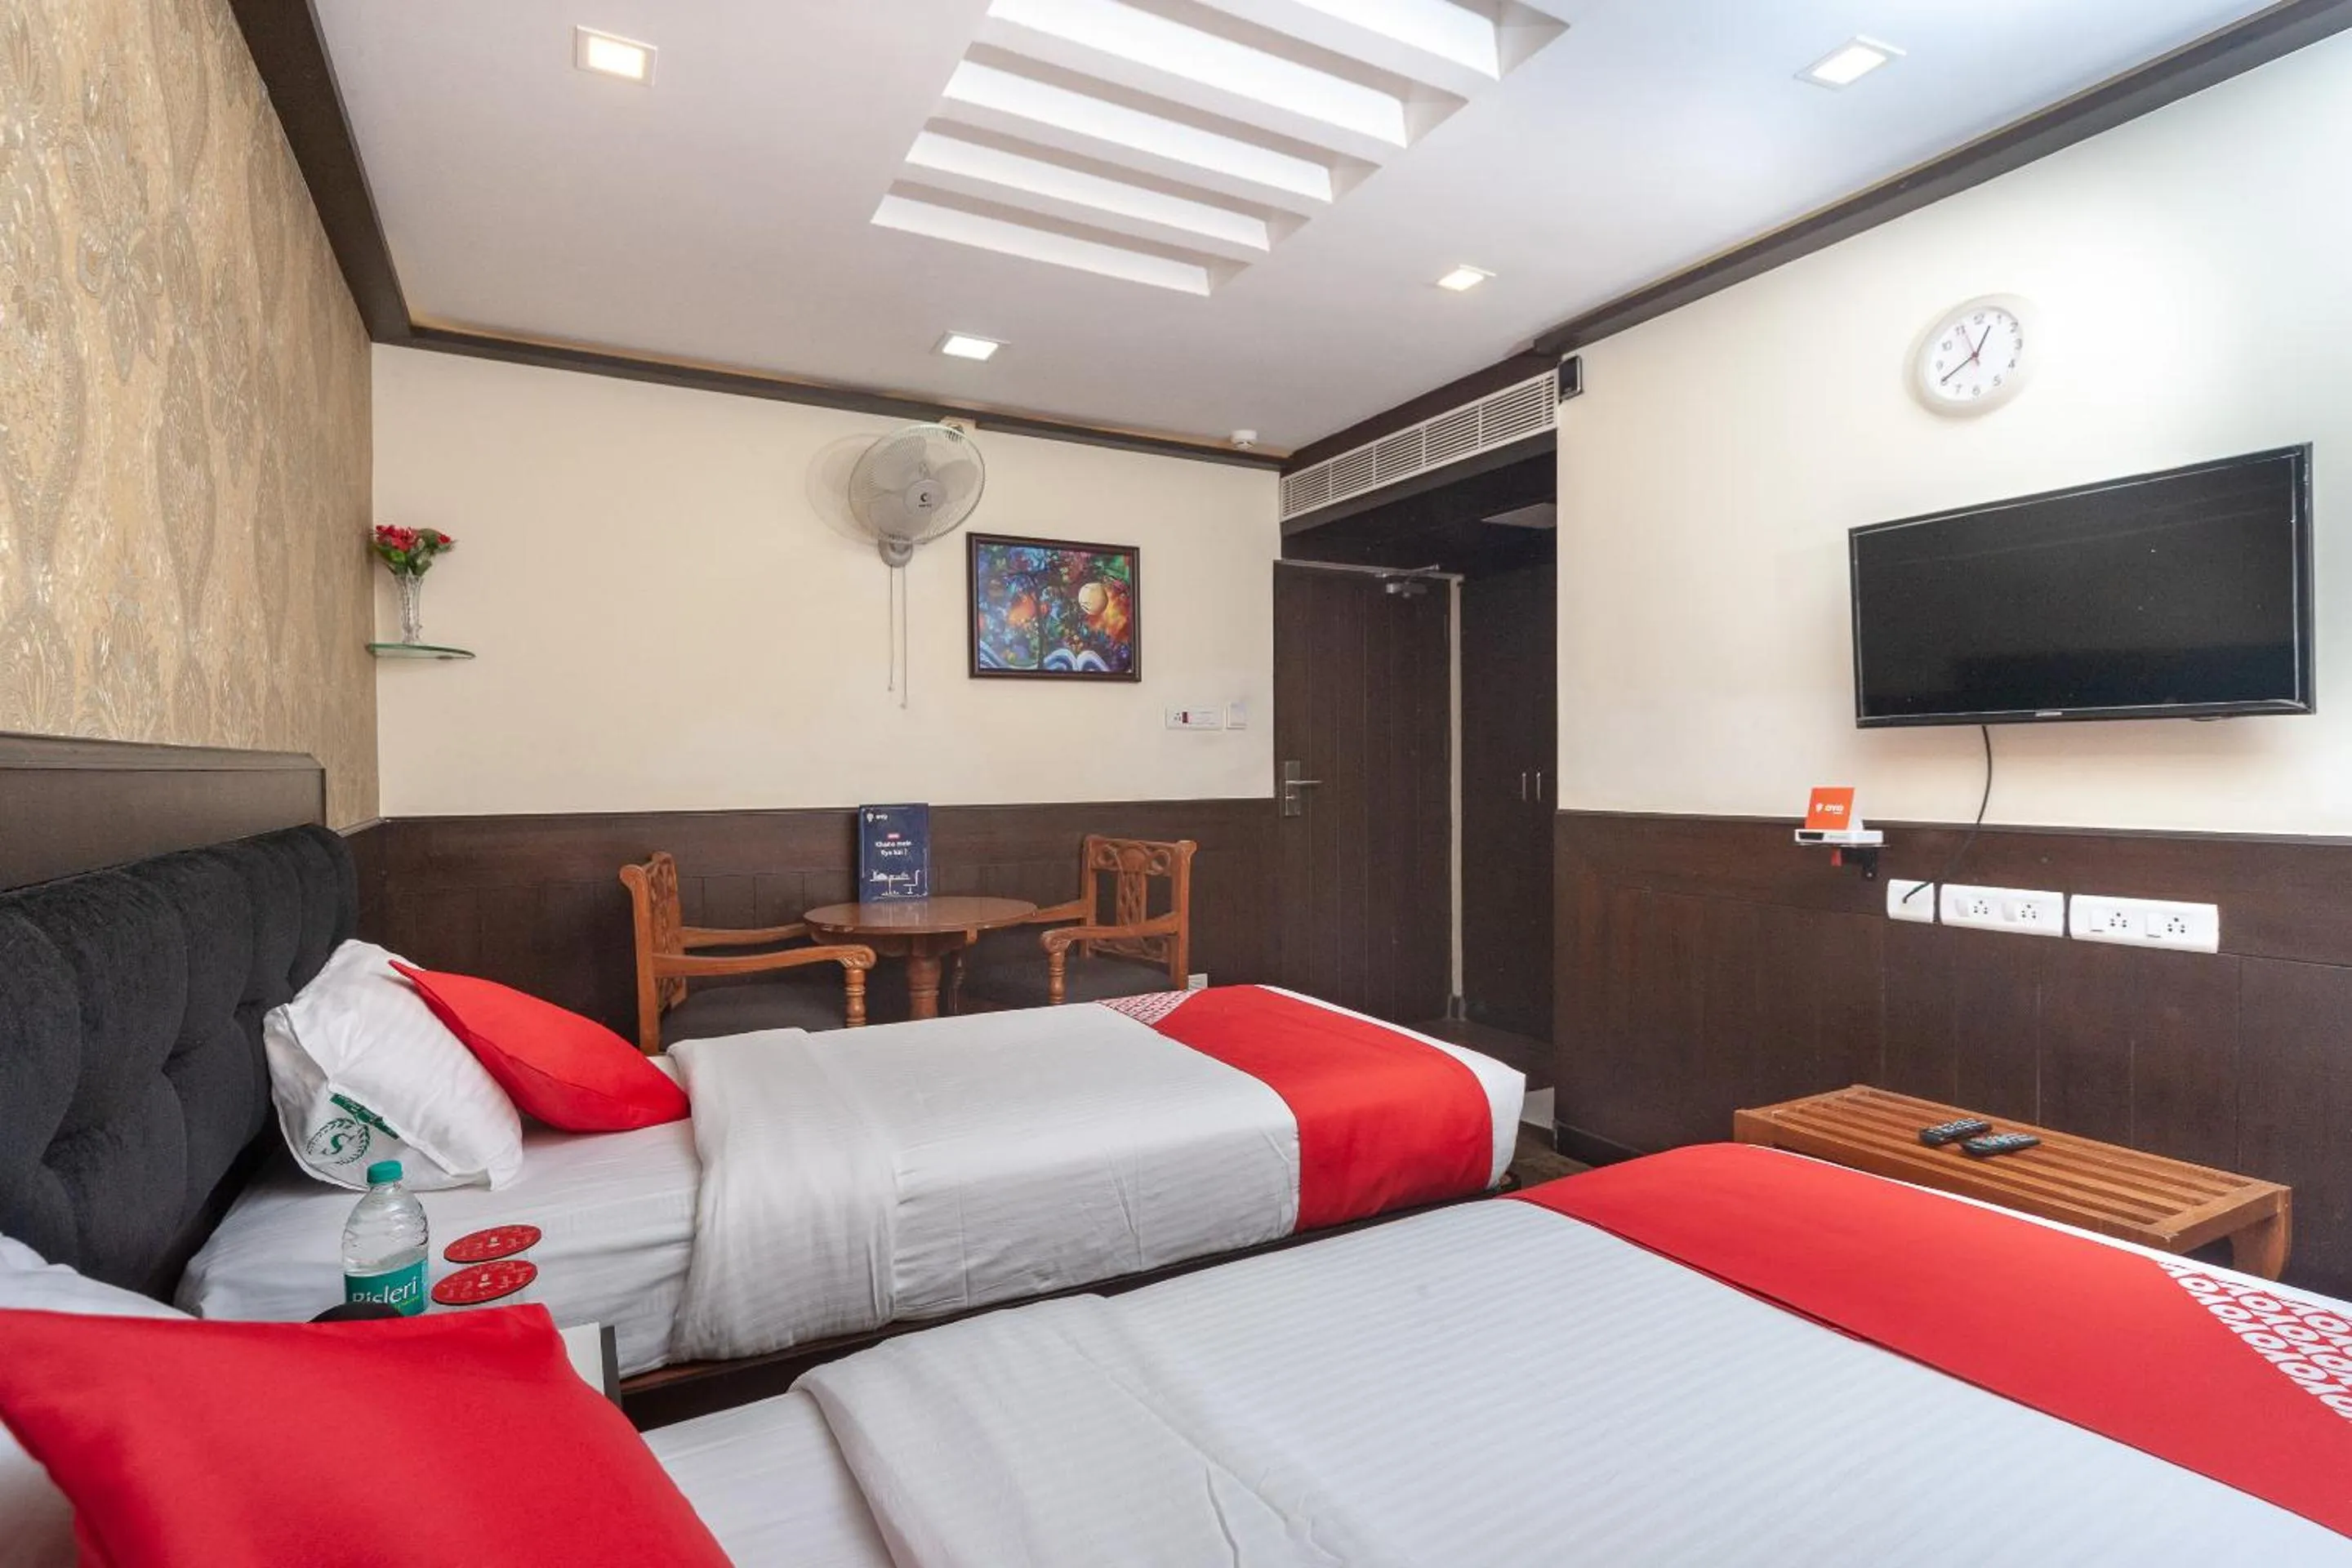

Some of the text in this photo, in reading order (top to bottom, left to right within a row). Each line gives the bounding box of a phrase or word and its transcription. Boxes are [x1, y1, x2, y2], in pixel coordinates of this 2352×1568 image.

[1973, 312, 1984, 325] 12
[2010, 321, 2018, 333] 2
[2015, 338, 2022, 350] 3
[1936, 360, 1944, 371] 9
[2008, 359, 2016, 368] 4
[1993, 375, 2001, 386] 5
[1956, 384, 1962, 394] 7
[1971, 385, 1980, 396] 6
